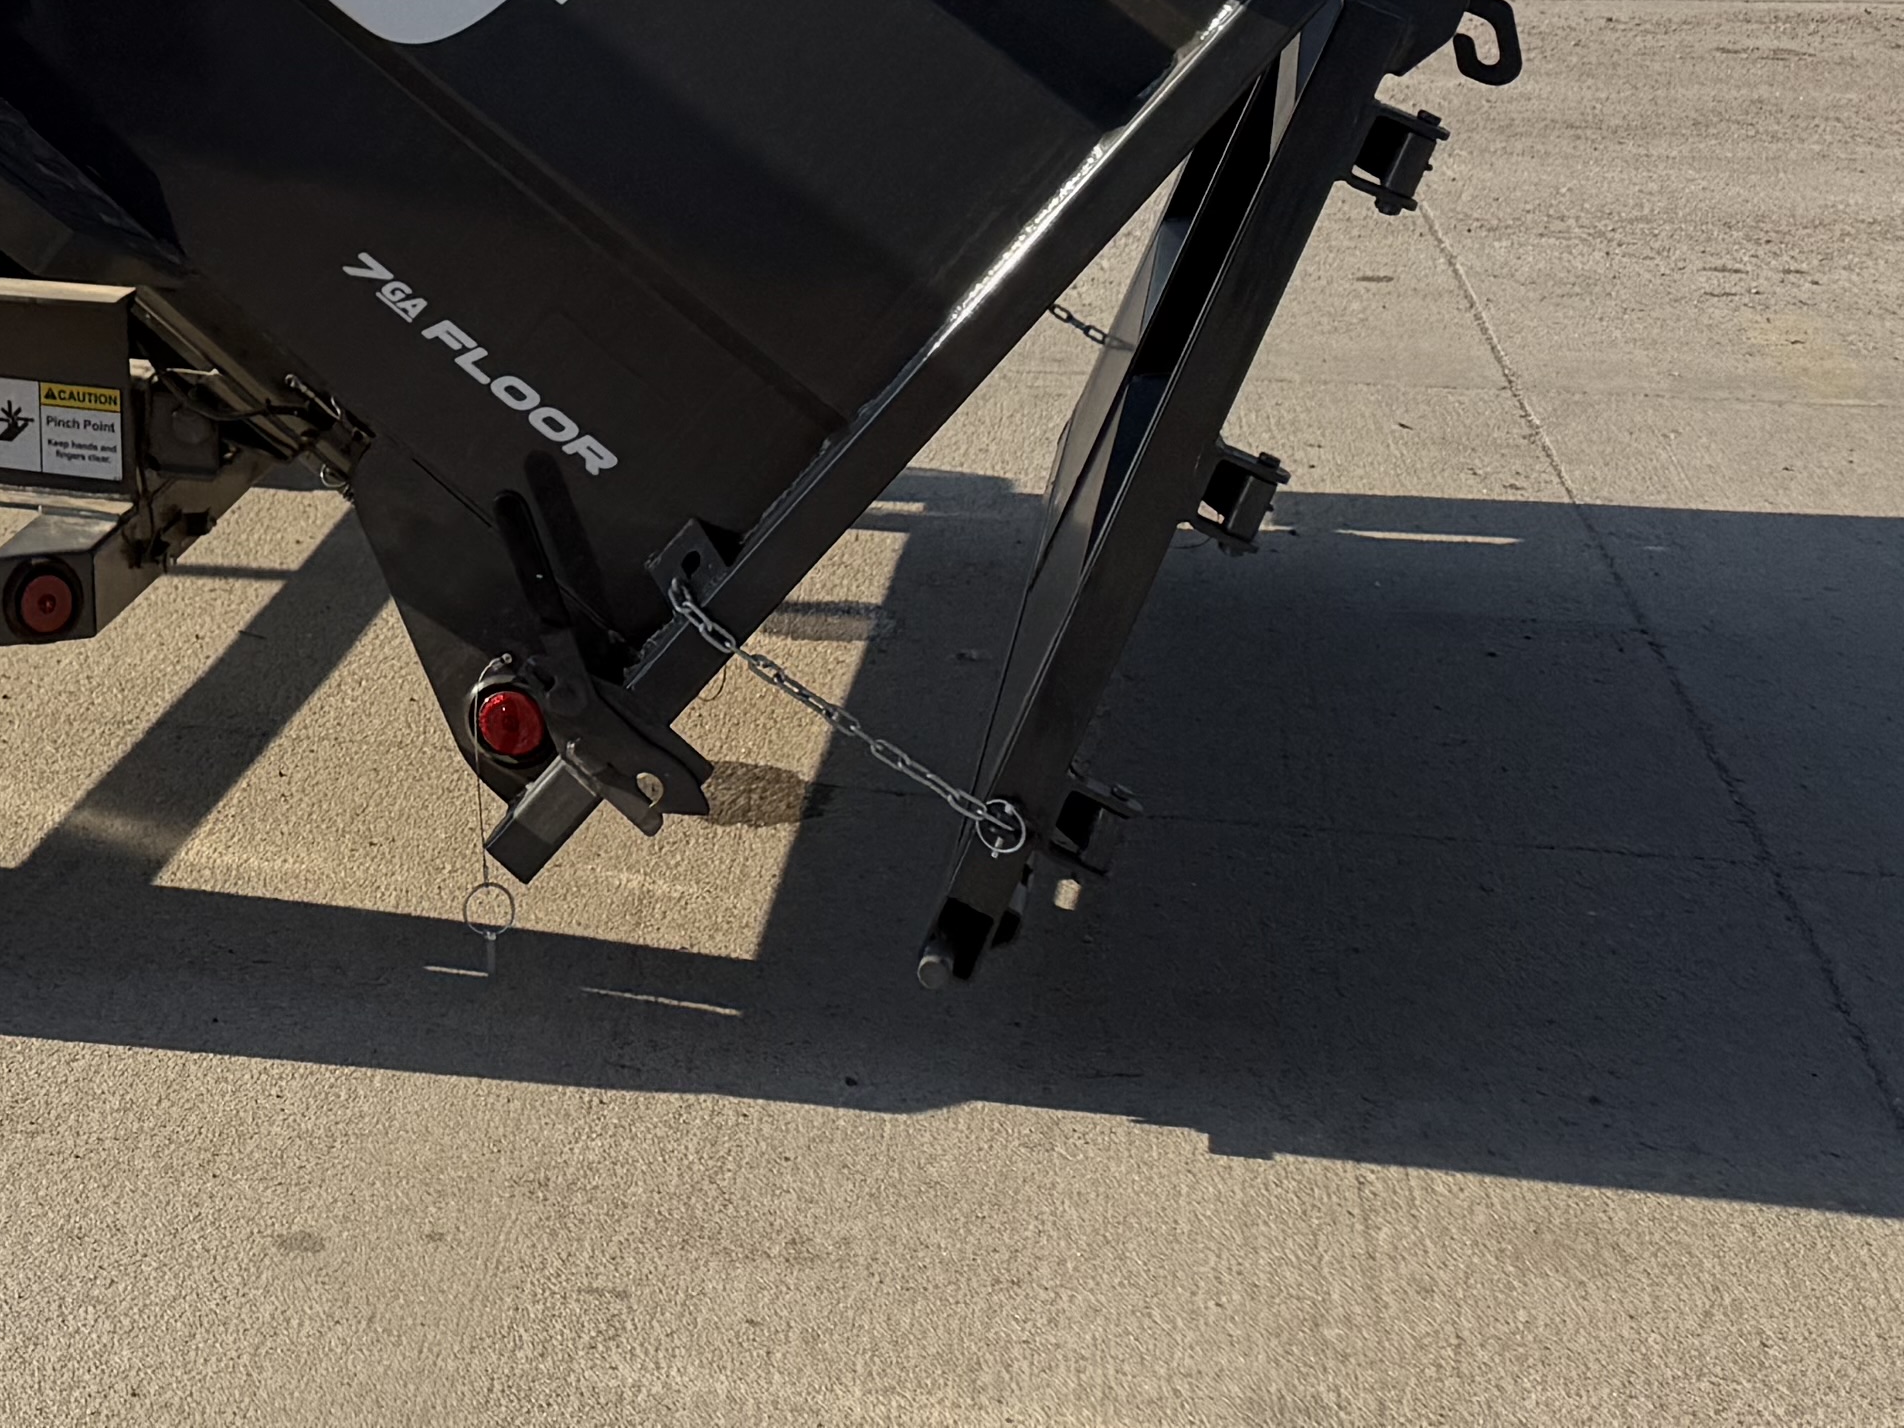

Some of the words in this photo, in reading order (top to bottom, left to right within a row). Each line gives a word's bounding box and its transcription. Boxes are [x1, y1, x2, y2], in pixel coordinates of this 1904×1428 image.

[58, 390, 118, 406] CAUTION
[420, 319, 619, 476] FLOOR
[46, 415, 80, 430] Pinch
[83, 419, 116, 433] Point
[47, 438, 69, 451] Keep
[71, 440, 98, 452] hands
[100, 443, 117, 454] and
[55, 448, 86, 462] fingers
